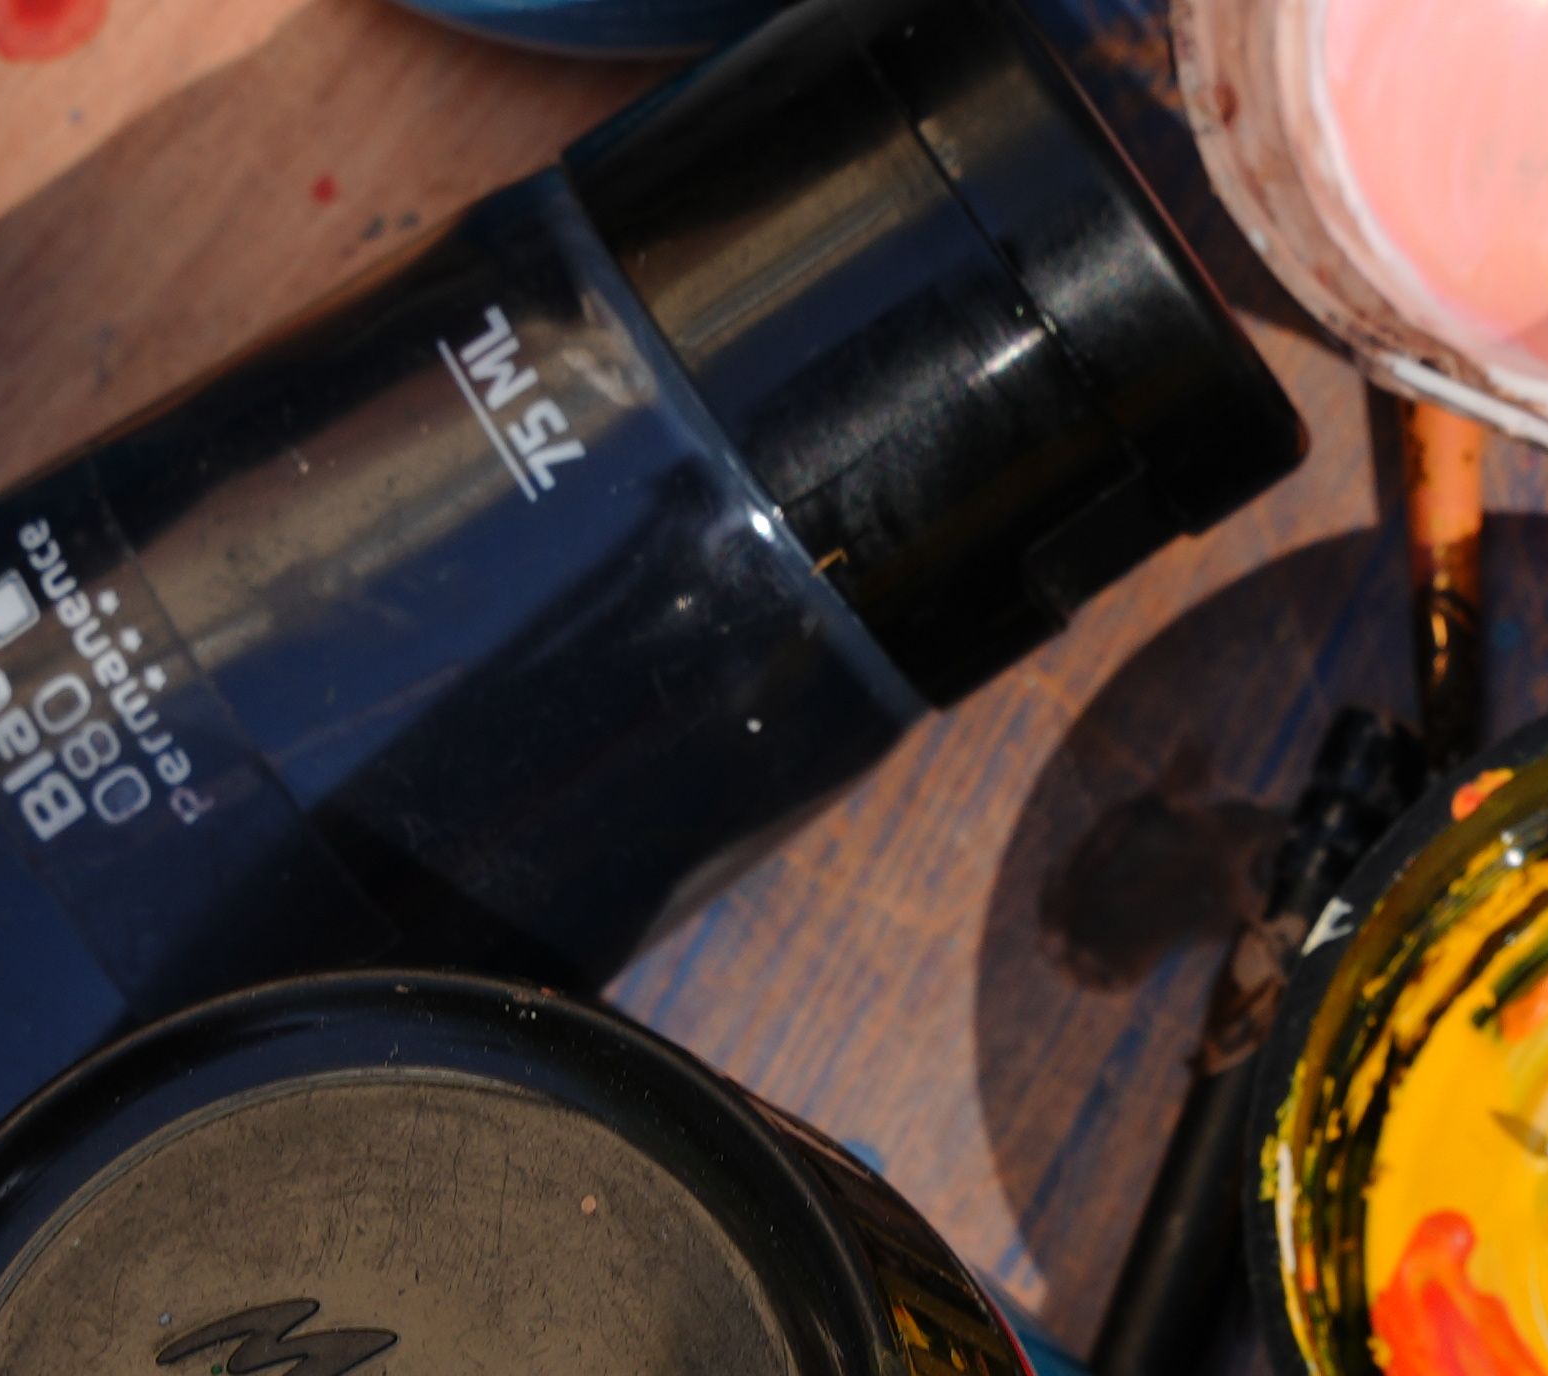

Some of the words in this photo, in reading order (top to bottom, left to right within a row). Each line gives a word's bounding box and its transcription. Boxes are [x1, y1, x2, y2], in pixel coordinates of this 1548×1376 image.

[460, 305, 539, 411] ML
[506, 399, 586, 491] 75
[18, 519, 215, 825] Permanence
[33, 672, 152, 825] 080
